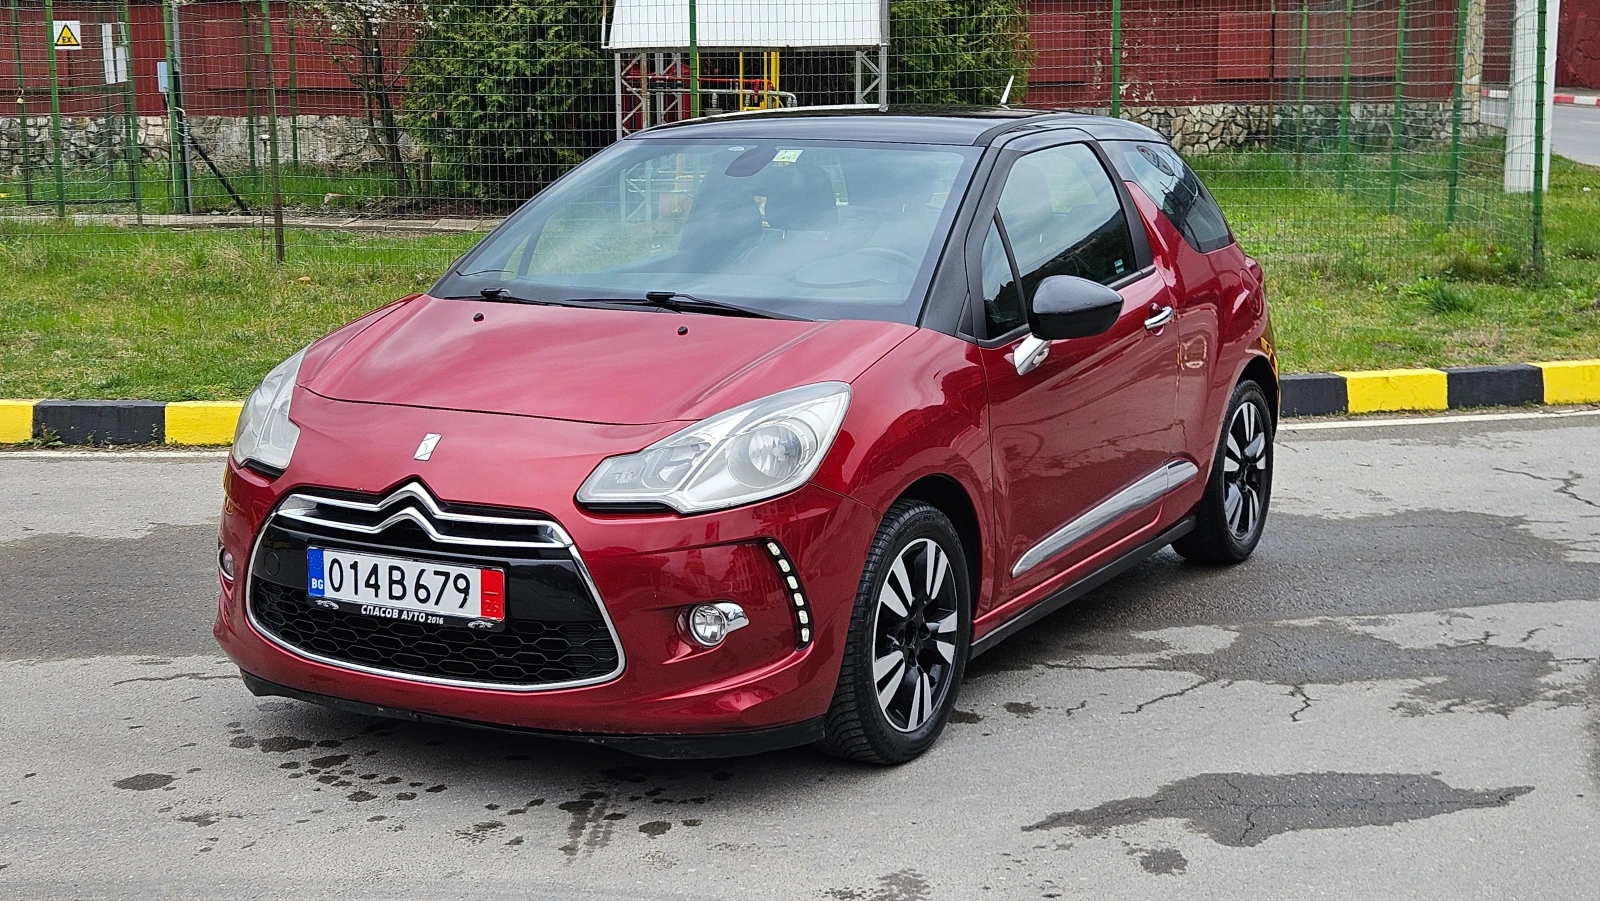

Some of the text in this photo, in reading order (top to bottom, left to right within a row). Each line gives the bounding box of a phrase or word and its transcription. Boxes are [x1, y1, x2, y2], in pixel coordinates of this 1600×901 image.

[62, 36, 73, 44] EX
[311, 578, 324, 590] BG
[328, 557, 471, 609] 014B679
[361, 605, 444, 625] СПАСОВ АУТО 2016
